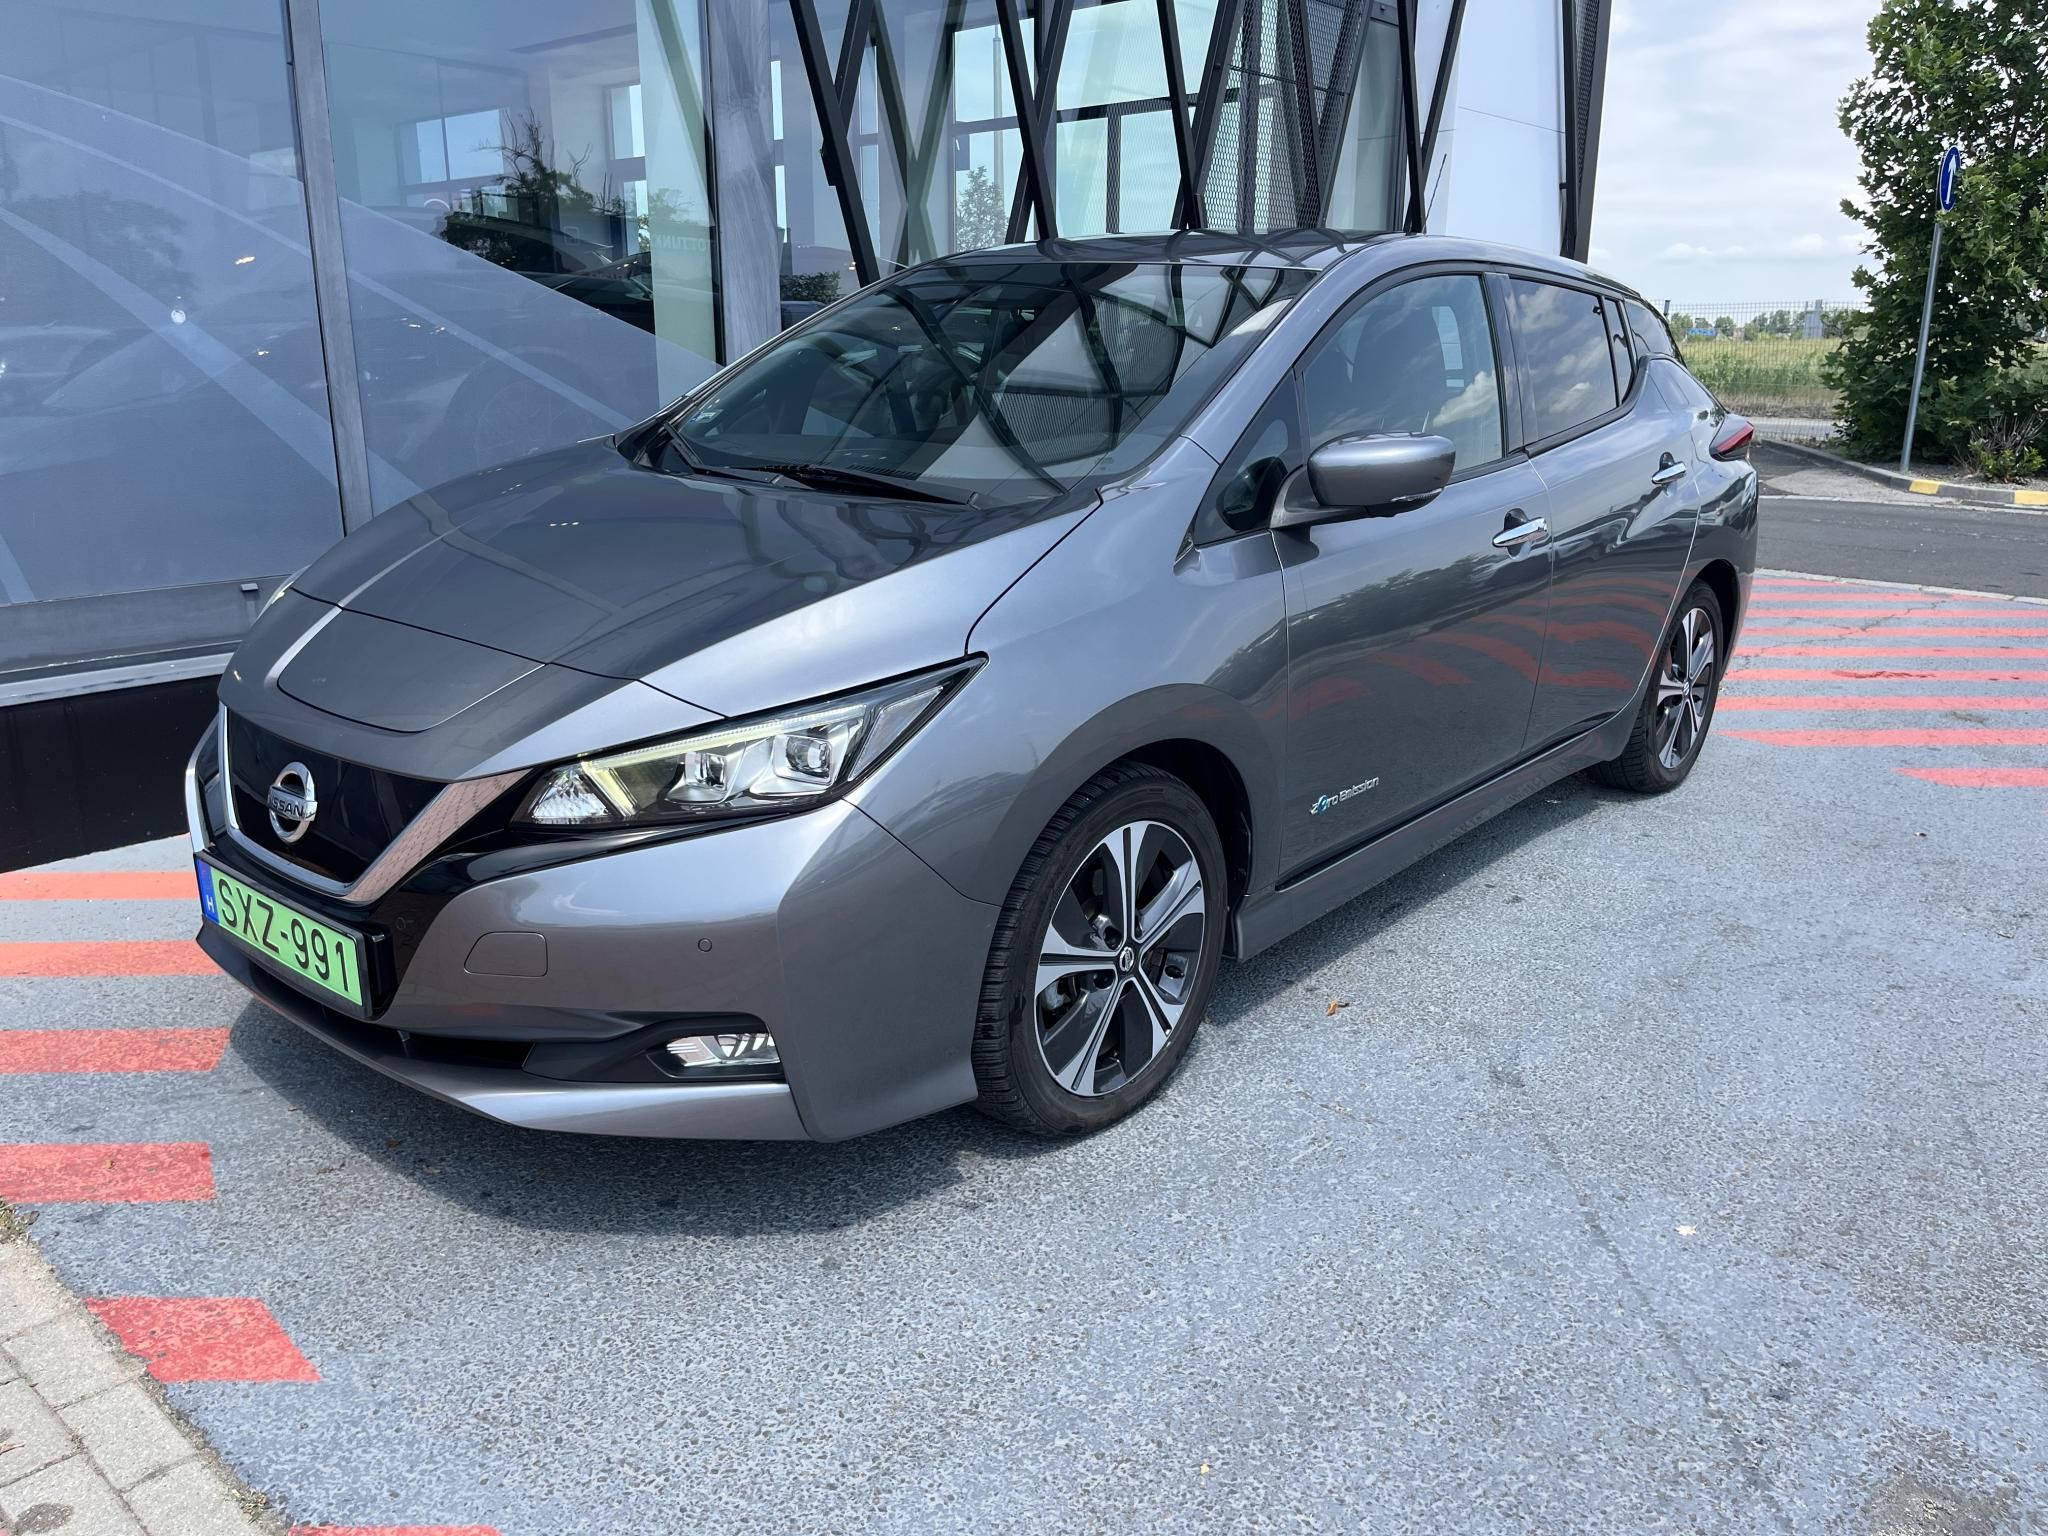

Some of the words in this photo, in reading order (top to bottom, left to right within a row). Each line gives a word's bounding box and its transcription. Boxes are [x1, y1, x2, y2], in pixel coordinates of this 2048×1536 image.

[1340, 777, 1379, 801] Emission
[271, 796, 305, 818] SSAN
[206, 895, 215, 913] H
[218, 878, 349, 993] SXZ-991
